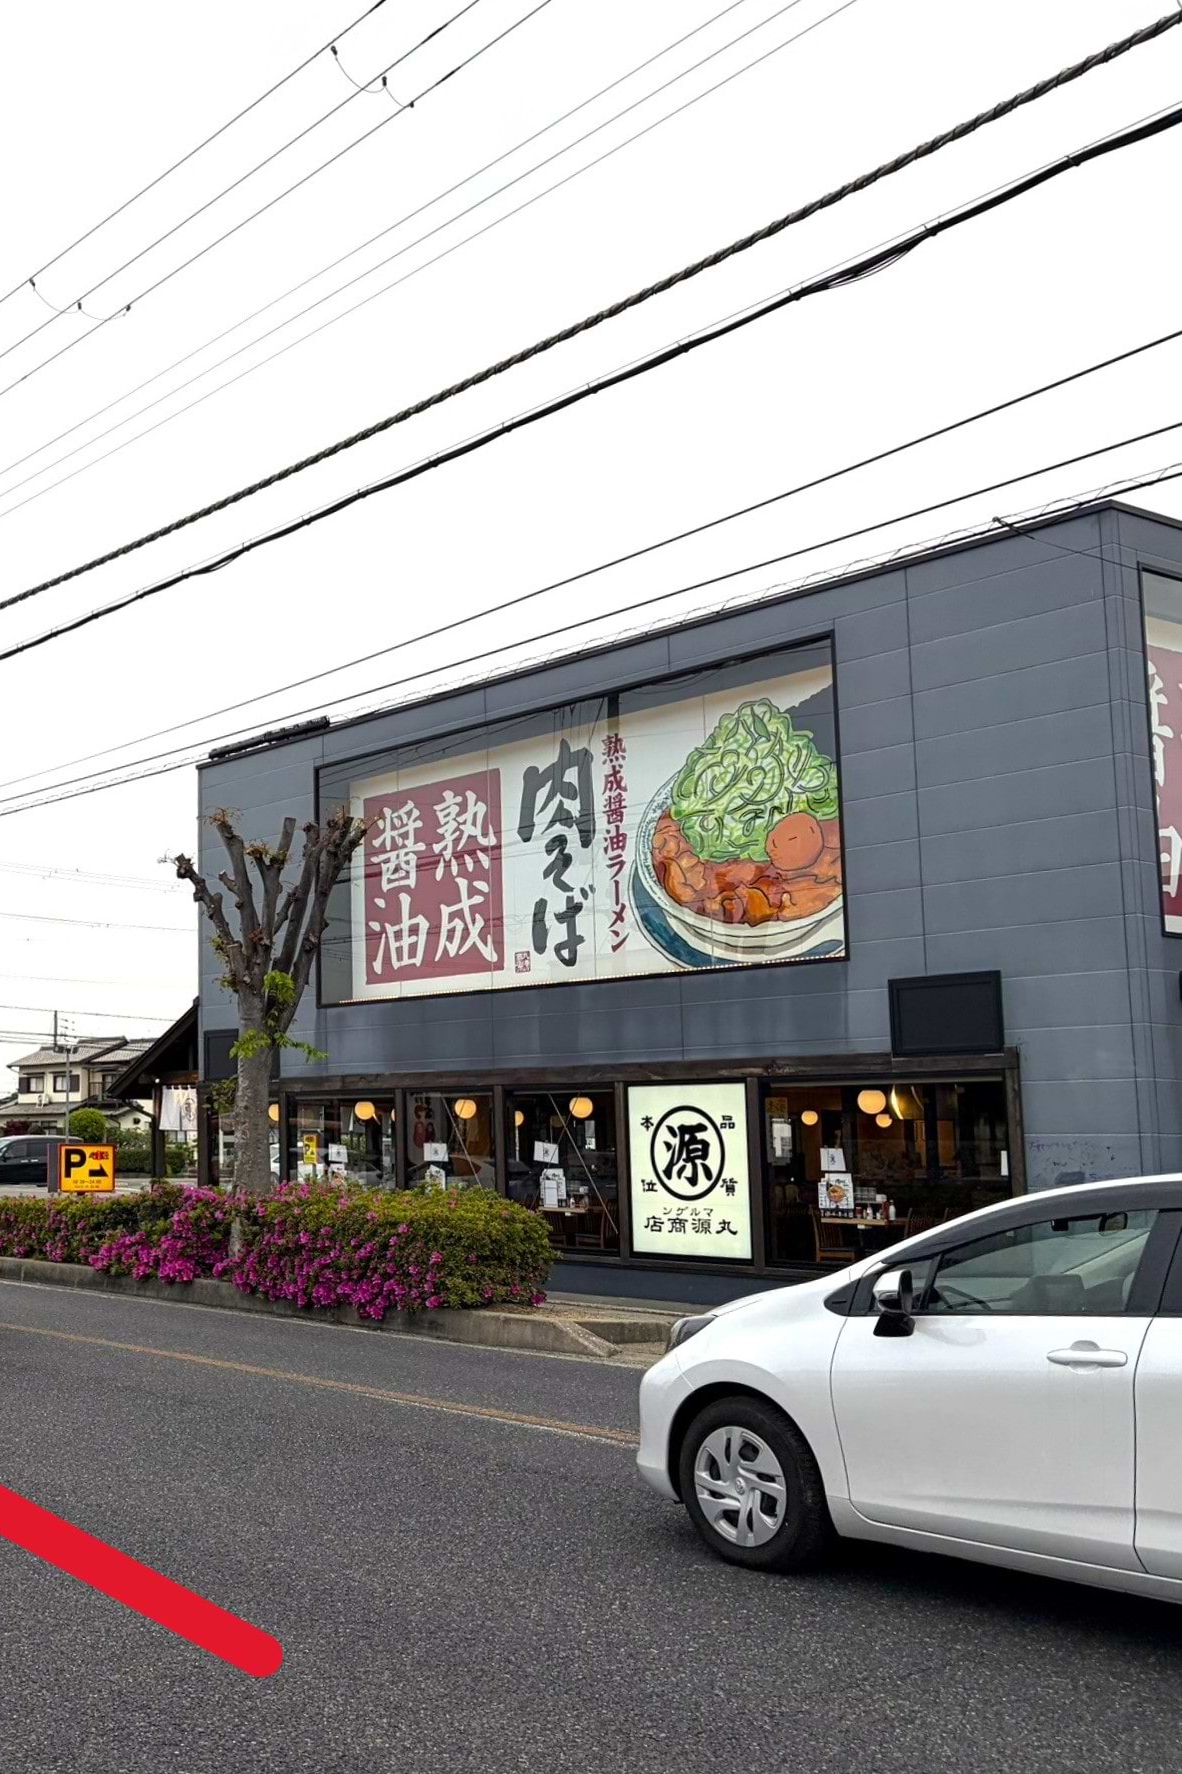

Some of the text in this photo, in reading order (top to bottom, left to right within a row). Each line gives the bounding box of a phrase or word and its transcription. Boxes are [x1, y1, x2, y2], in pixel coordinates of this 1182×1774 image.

[432, 788, 498, 963] 熟成
[517, 738, 596, 967] 肉そば
[600, 733, 631, 953] 熟成醤油ラーメン
[64, 1148, 87, 1178] P
[662, 1122, 714, 1187] 源
